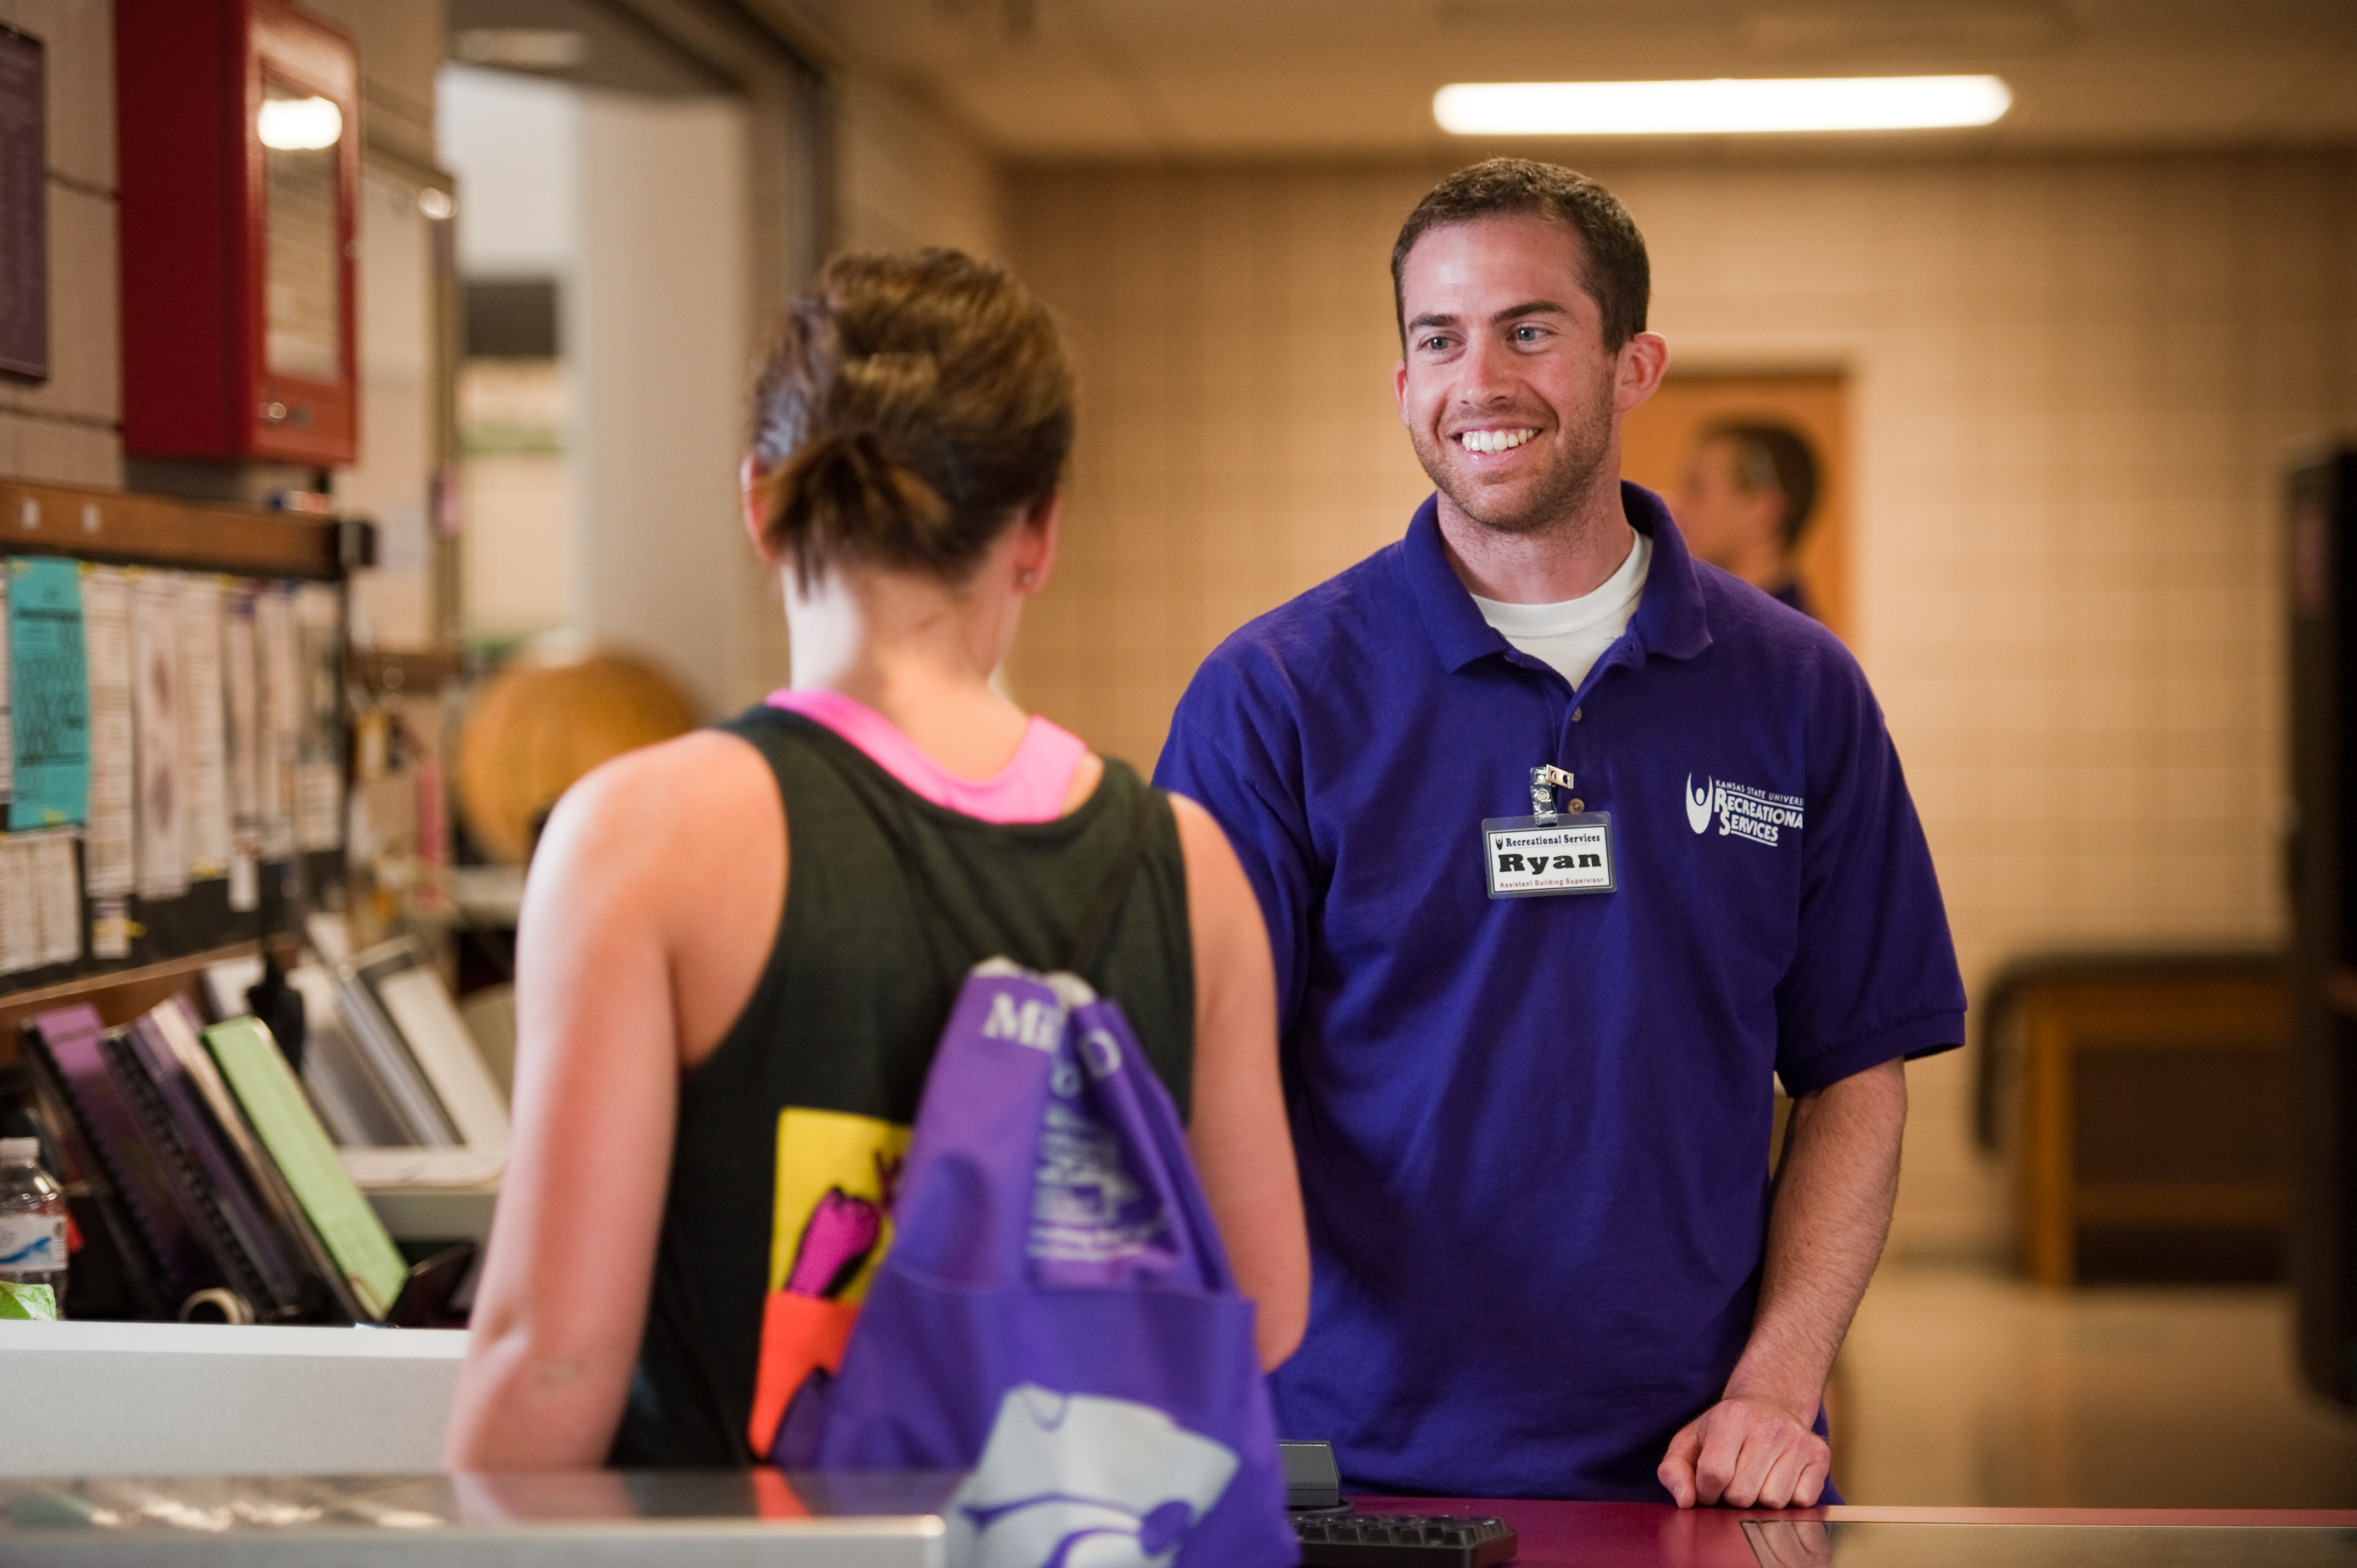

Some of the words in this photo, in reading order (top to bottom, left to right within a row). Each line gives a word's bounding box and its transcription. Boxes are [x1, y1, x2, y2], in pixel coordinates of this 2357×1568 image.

[1715, 780, 1745, 793] KANSAS
[1747, 787, 1766, 797] STATE
[1768, 792, 1804, 807] UNIVERS
[1713, 787, 1803, 829] RECREATIONA
[1718, 808, 1779, 842] SERVICES
[1506, 835, 1562, 847] Recreational
[1563, 834, 1601, 843] Services
[1498, 854, 1602, 875] Ryan
